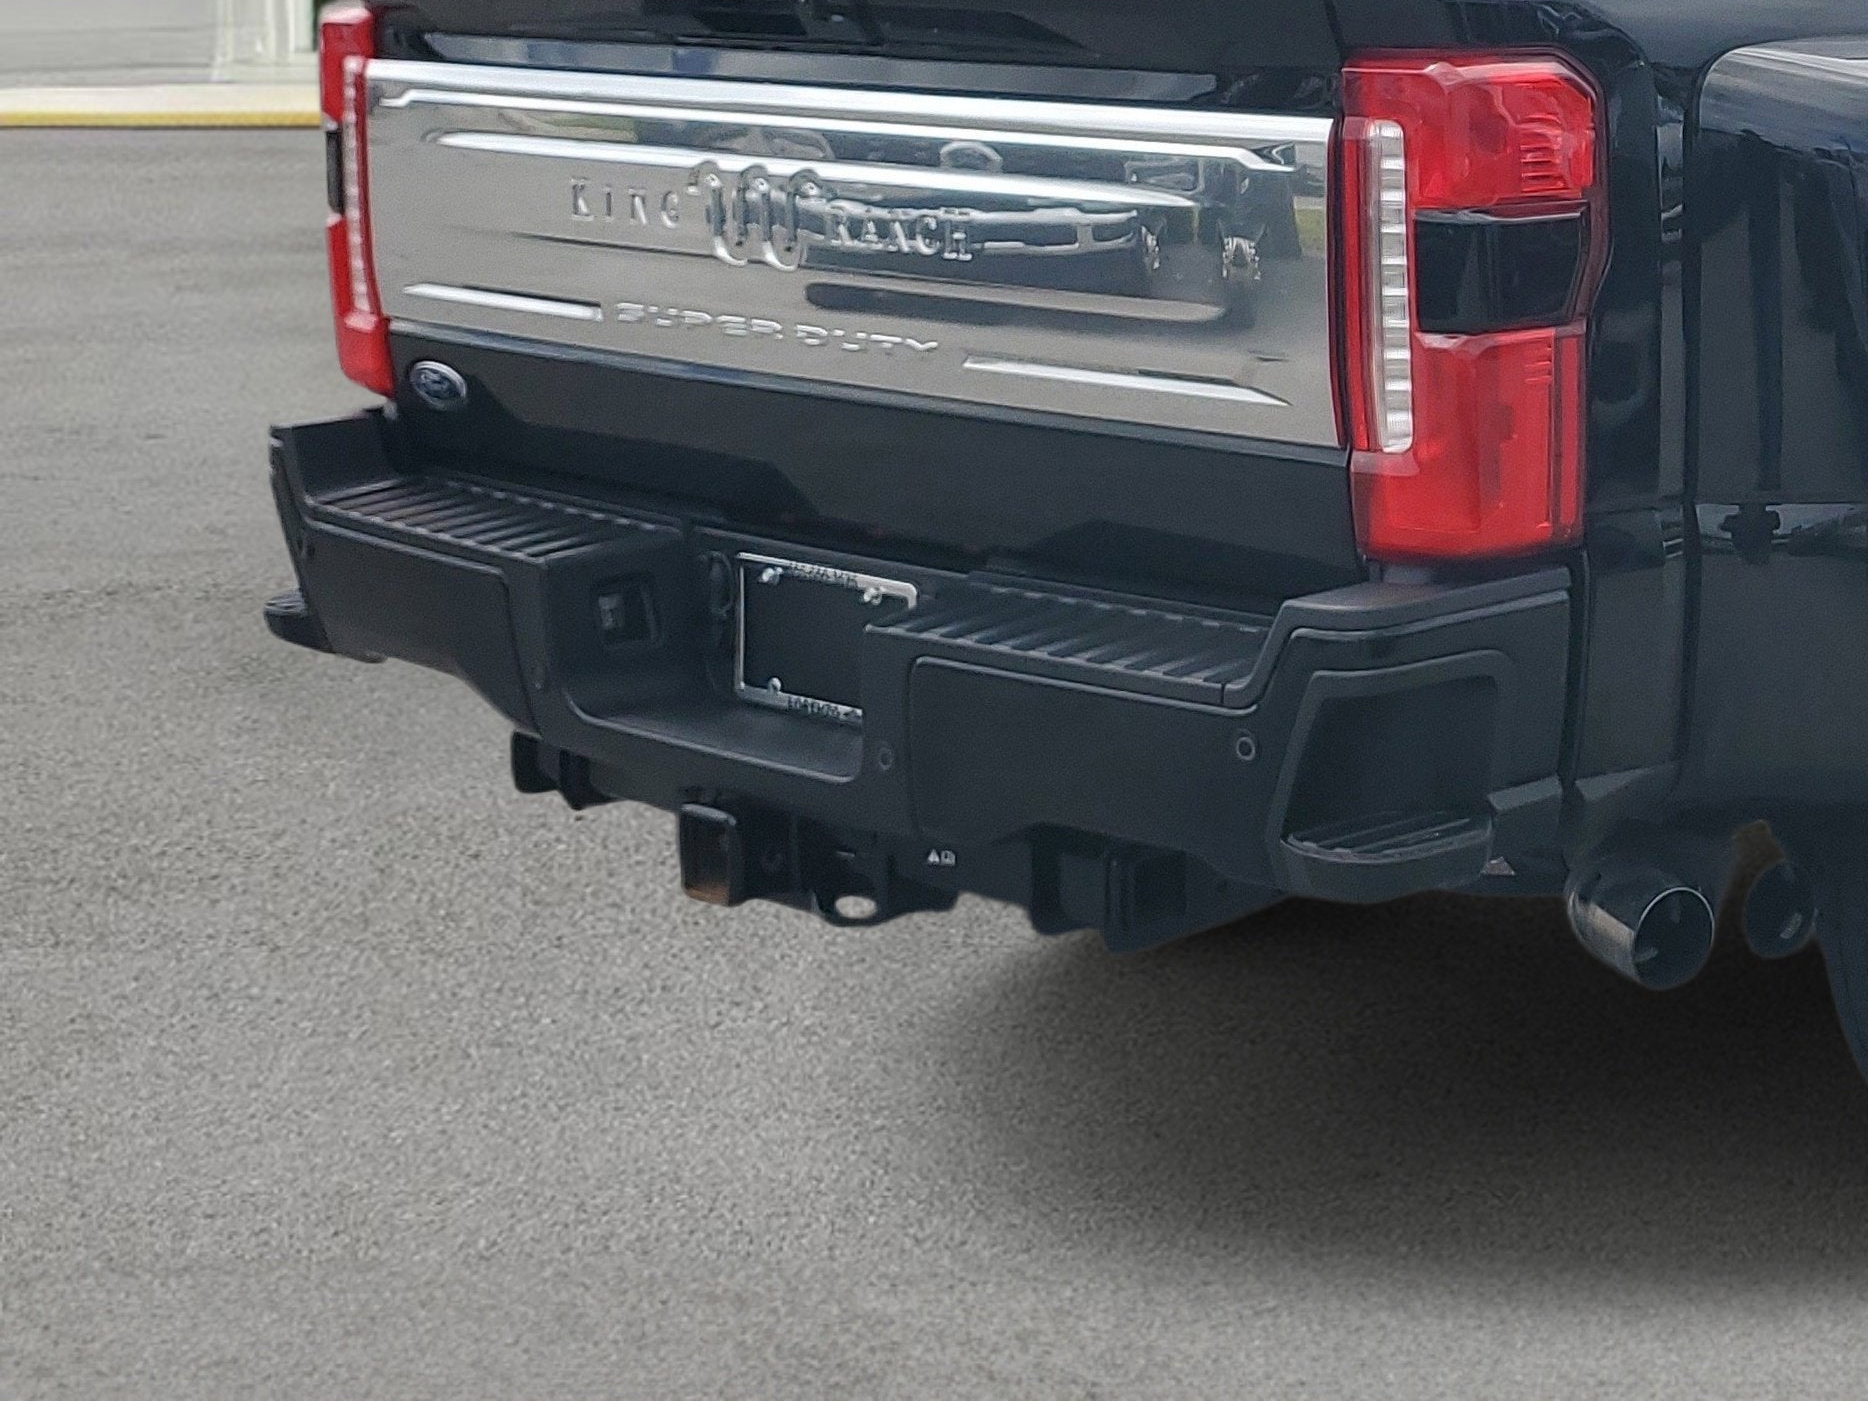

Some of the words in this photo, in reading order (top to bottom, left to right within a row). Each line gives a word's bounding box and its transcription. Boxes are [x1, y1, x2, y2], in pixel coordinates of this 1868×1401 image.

[569, 175, 681, 230] KING
[824, 200, 973, 262] RANCH
[615, 301, 783, 342] SUPER
[796, 324, 939, 355] DUTY
